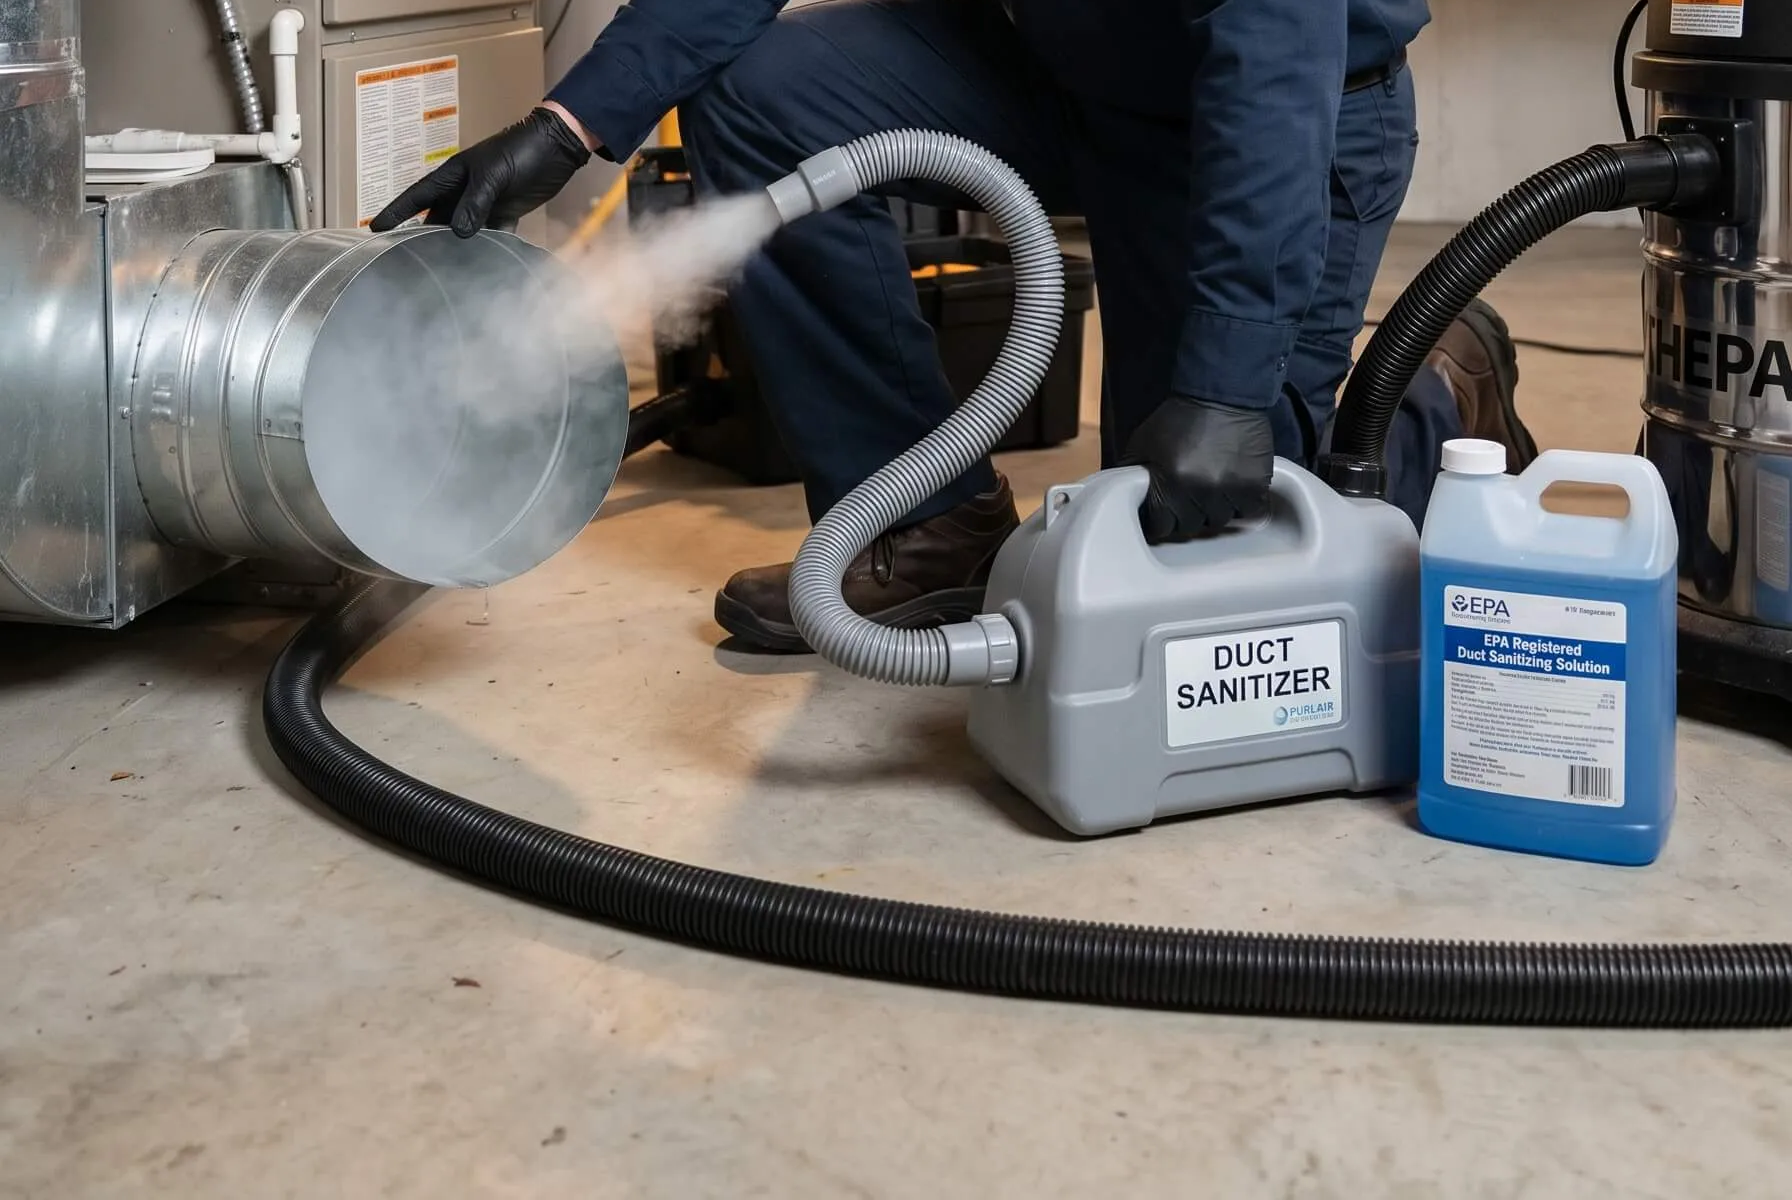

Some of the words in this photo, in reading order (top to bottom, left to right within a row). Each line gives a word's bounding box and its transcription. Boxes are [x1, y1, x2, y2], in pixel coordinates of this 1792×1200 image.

[1656, 318, 1792, 402] HEPA
[1470, 596, 1511, 618] EPA
[1214, 636, 1294, 671] DUCT
[1457, 646, 1486, 662] Duct
[1488, 650, 1552, 672] Sanitizing
[1556, 657, 1610, 675] Solution
[1484, 633, 1510, 649] EPA
[1513, 636, 1582, 657] Registered
[1177, 666, 1332, 710] SANITIZER
